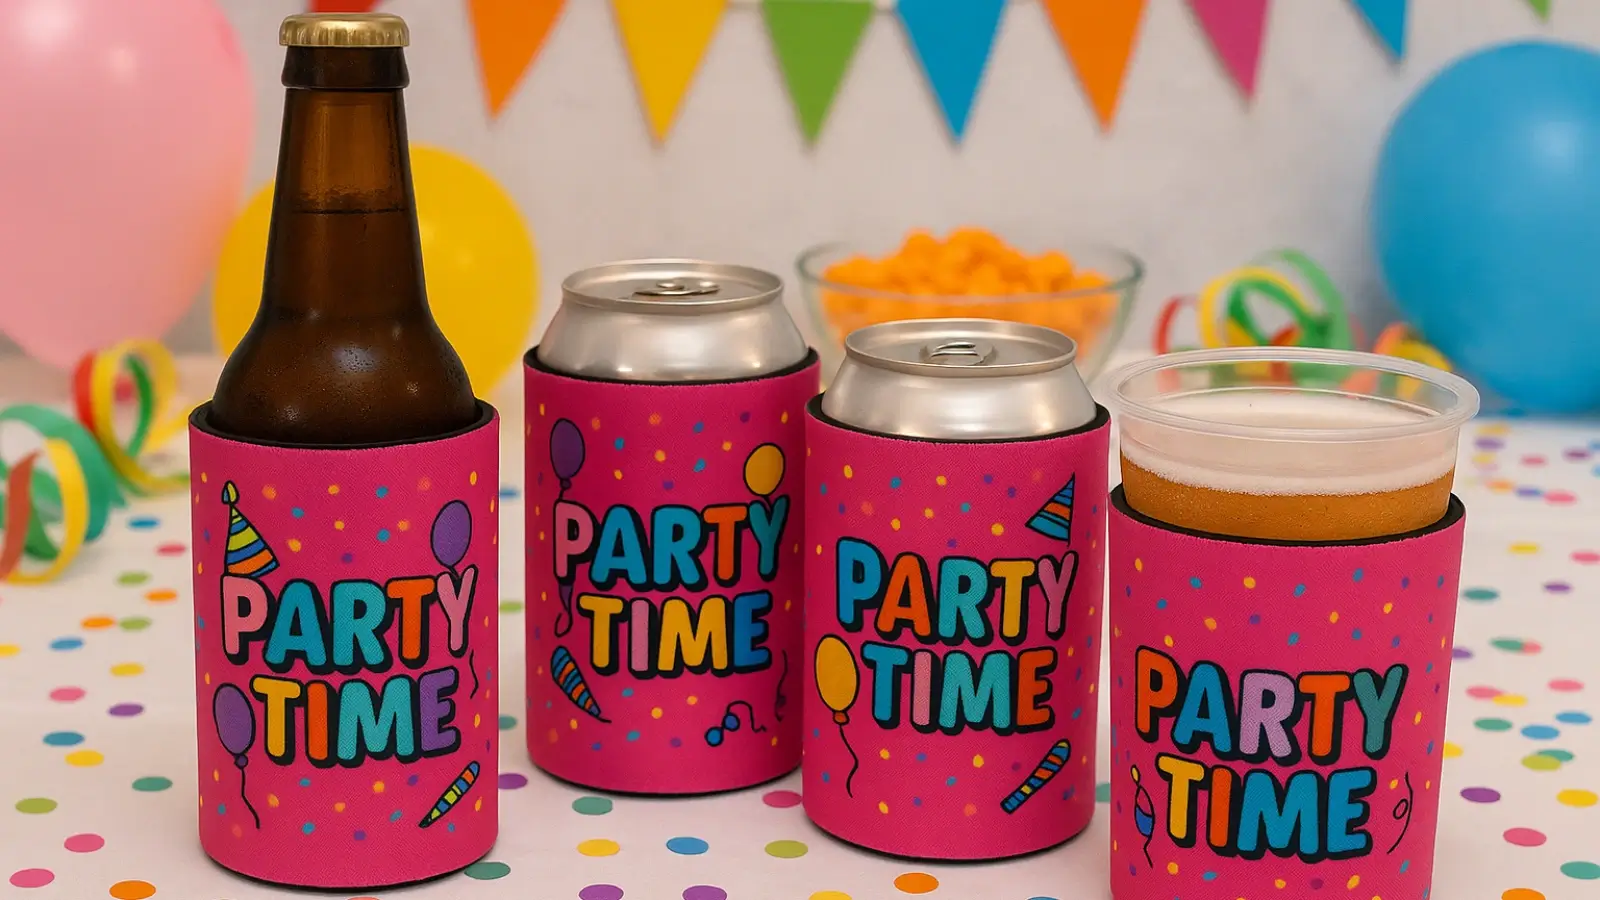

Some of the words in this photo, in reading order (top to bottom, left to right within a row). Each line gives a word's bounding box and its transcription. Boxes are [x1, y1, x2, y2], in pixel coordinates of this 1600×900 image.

[553, 495, 790, 592] PARTY
[836, 536, 1079, 647] PARTY
[220, 564, 478, 674] PARTY
[577, 589, 772, 680] TIME
[250, 665, 461, 768] TIME
[860, 640, 1058, 736] TIME
[1135, 645, 1409, 766] PARTY
[1155, 752, 1377, 863] TIME
